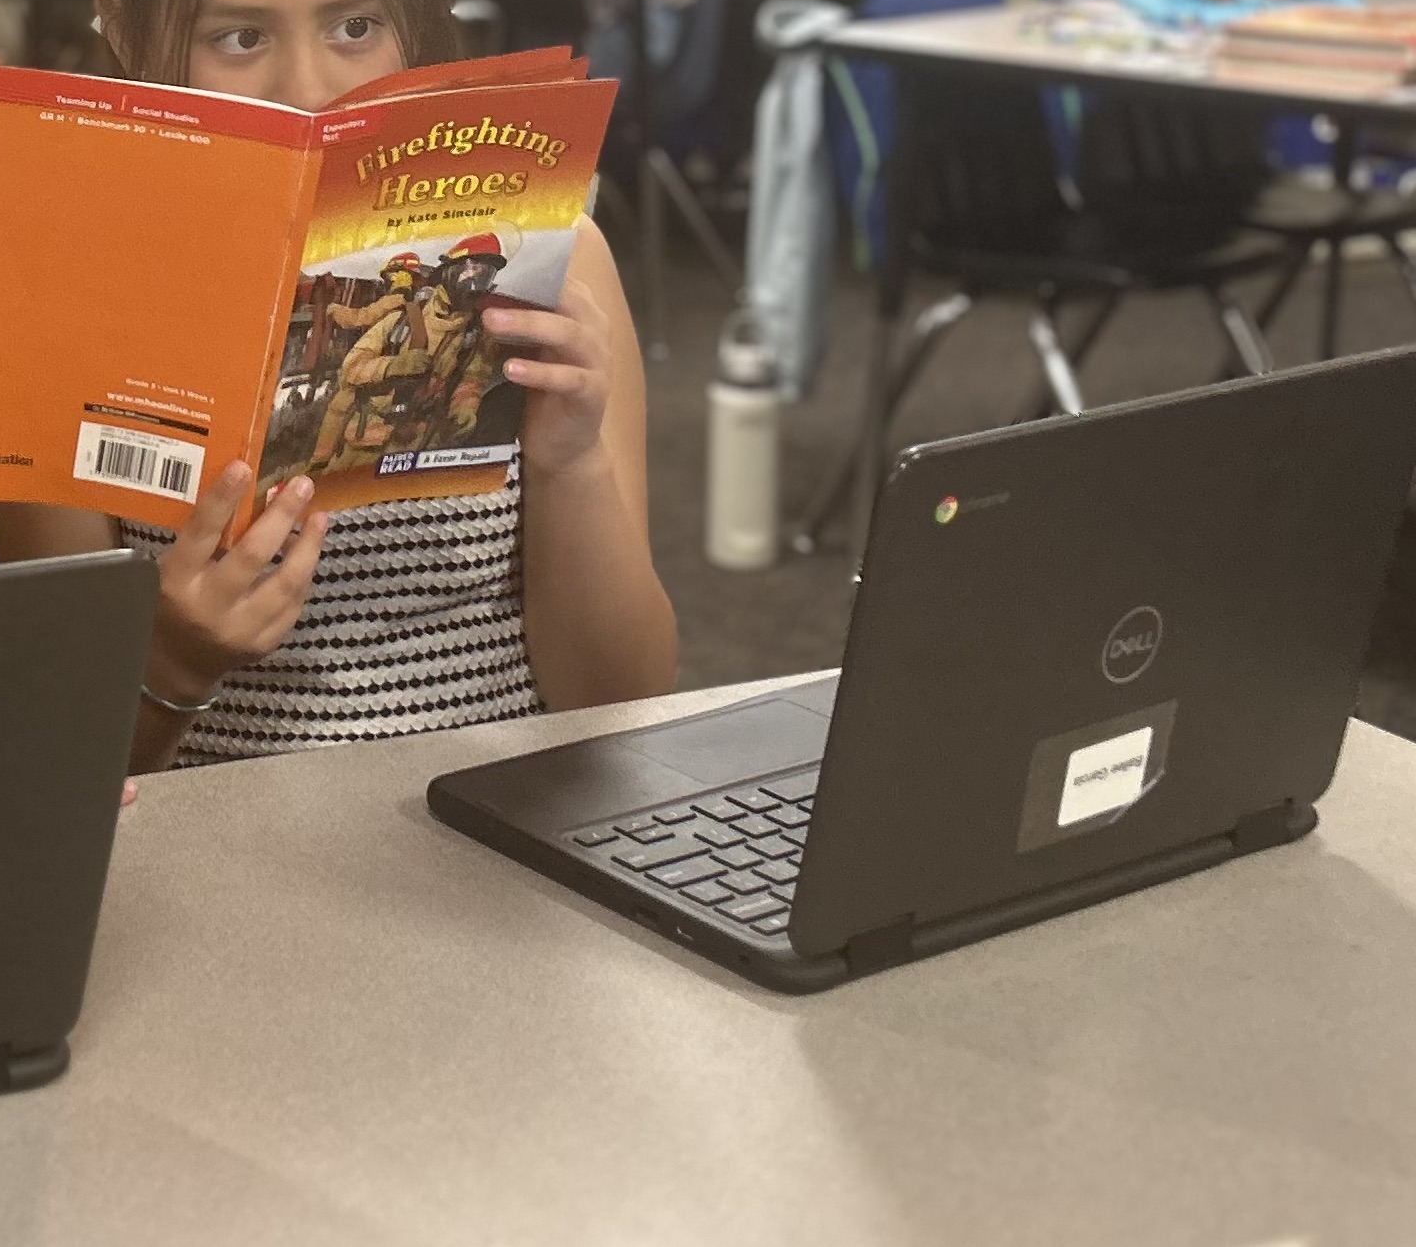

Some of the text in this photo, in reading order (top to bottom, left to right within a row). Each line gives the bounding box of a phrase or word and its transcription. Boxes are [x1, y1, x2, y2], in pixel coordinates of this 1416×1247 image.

[55, 95, 113, 112] Teaming Up
[77, 116, 131, 132] Benchmark
[132, 105, 201, 124] Social Studies
[355, 116, 570, 182] Firefighting
[372, 169, 530, 211] Heroes
[386, 206, 497, 229] by Kate Sinclair
[379, 460, 413, 474] READ
[1110, 630, 1155, 659] DELL
